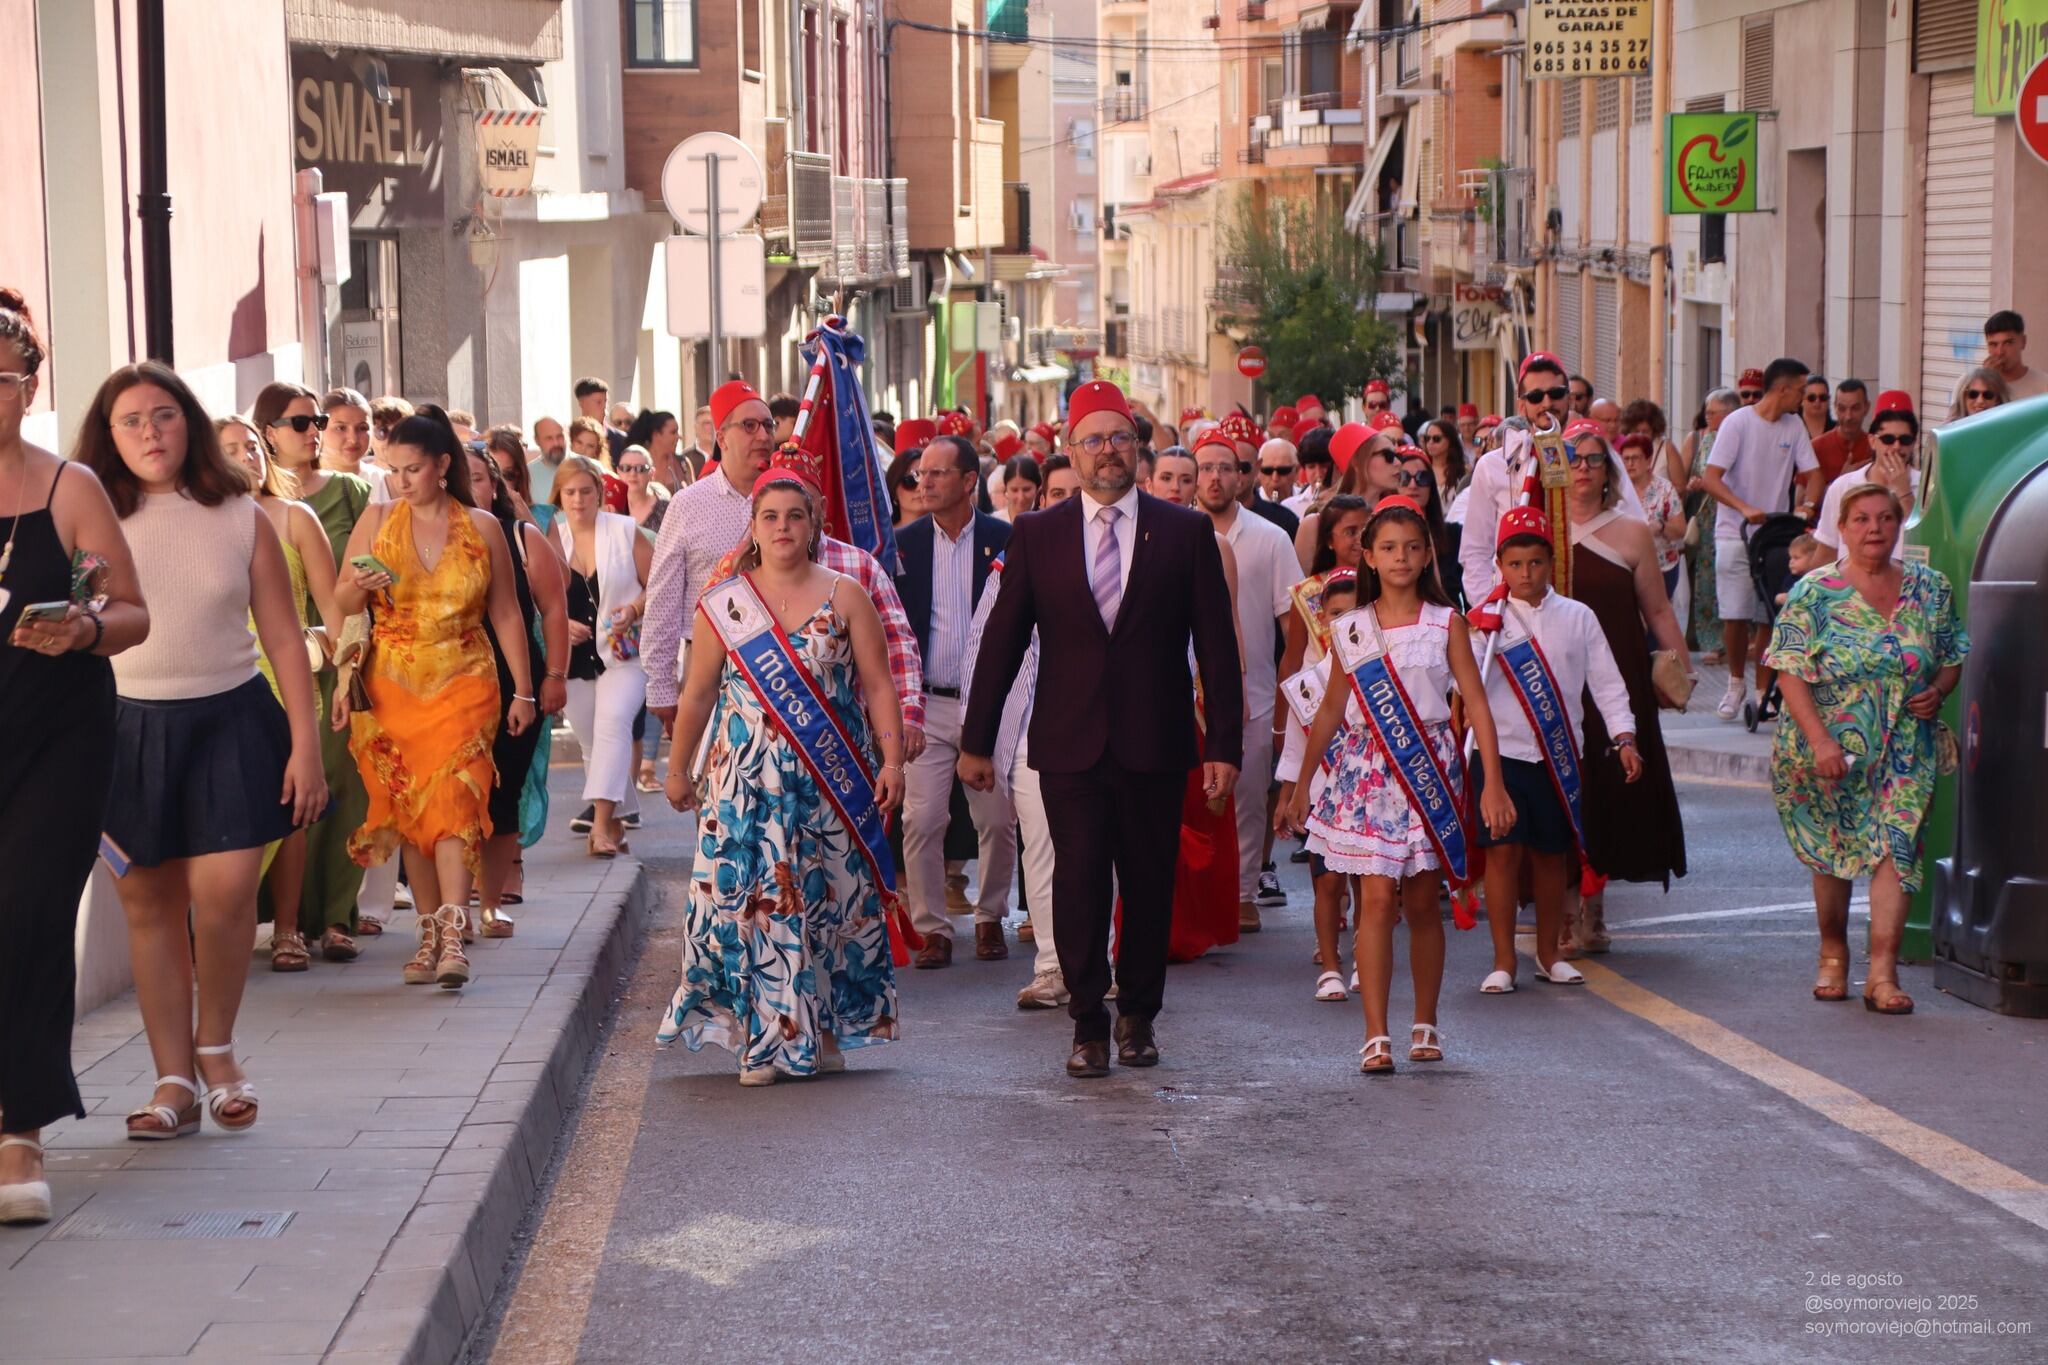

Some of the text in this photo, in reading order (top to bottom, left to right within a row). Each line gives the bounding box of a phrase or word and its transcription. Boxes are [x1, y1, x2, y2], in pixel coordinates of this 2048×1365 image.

[1545, 6, 1638, 18] PLAZAS DE
[1558, 21, 1624, 32] GARAJE
[1533, 39, 1648, 54] 965 34 35 27
[1533, 56, 1648, 71] 685 81 80 66
[486, 149, 529, 166] ISMAEL
[1688, 165, 1738, 180] FRUTAS
[1456, 307, 1492, 341] Ely
[754, 649, 812, 727] Moros
[815, 728, 854, 794] Viejos
[1520, 659, 1572, 777] Moros Viejos
[1369, 679, 1411, 749] Moros
[1409, 752, 1442, 811] Viejos
